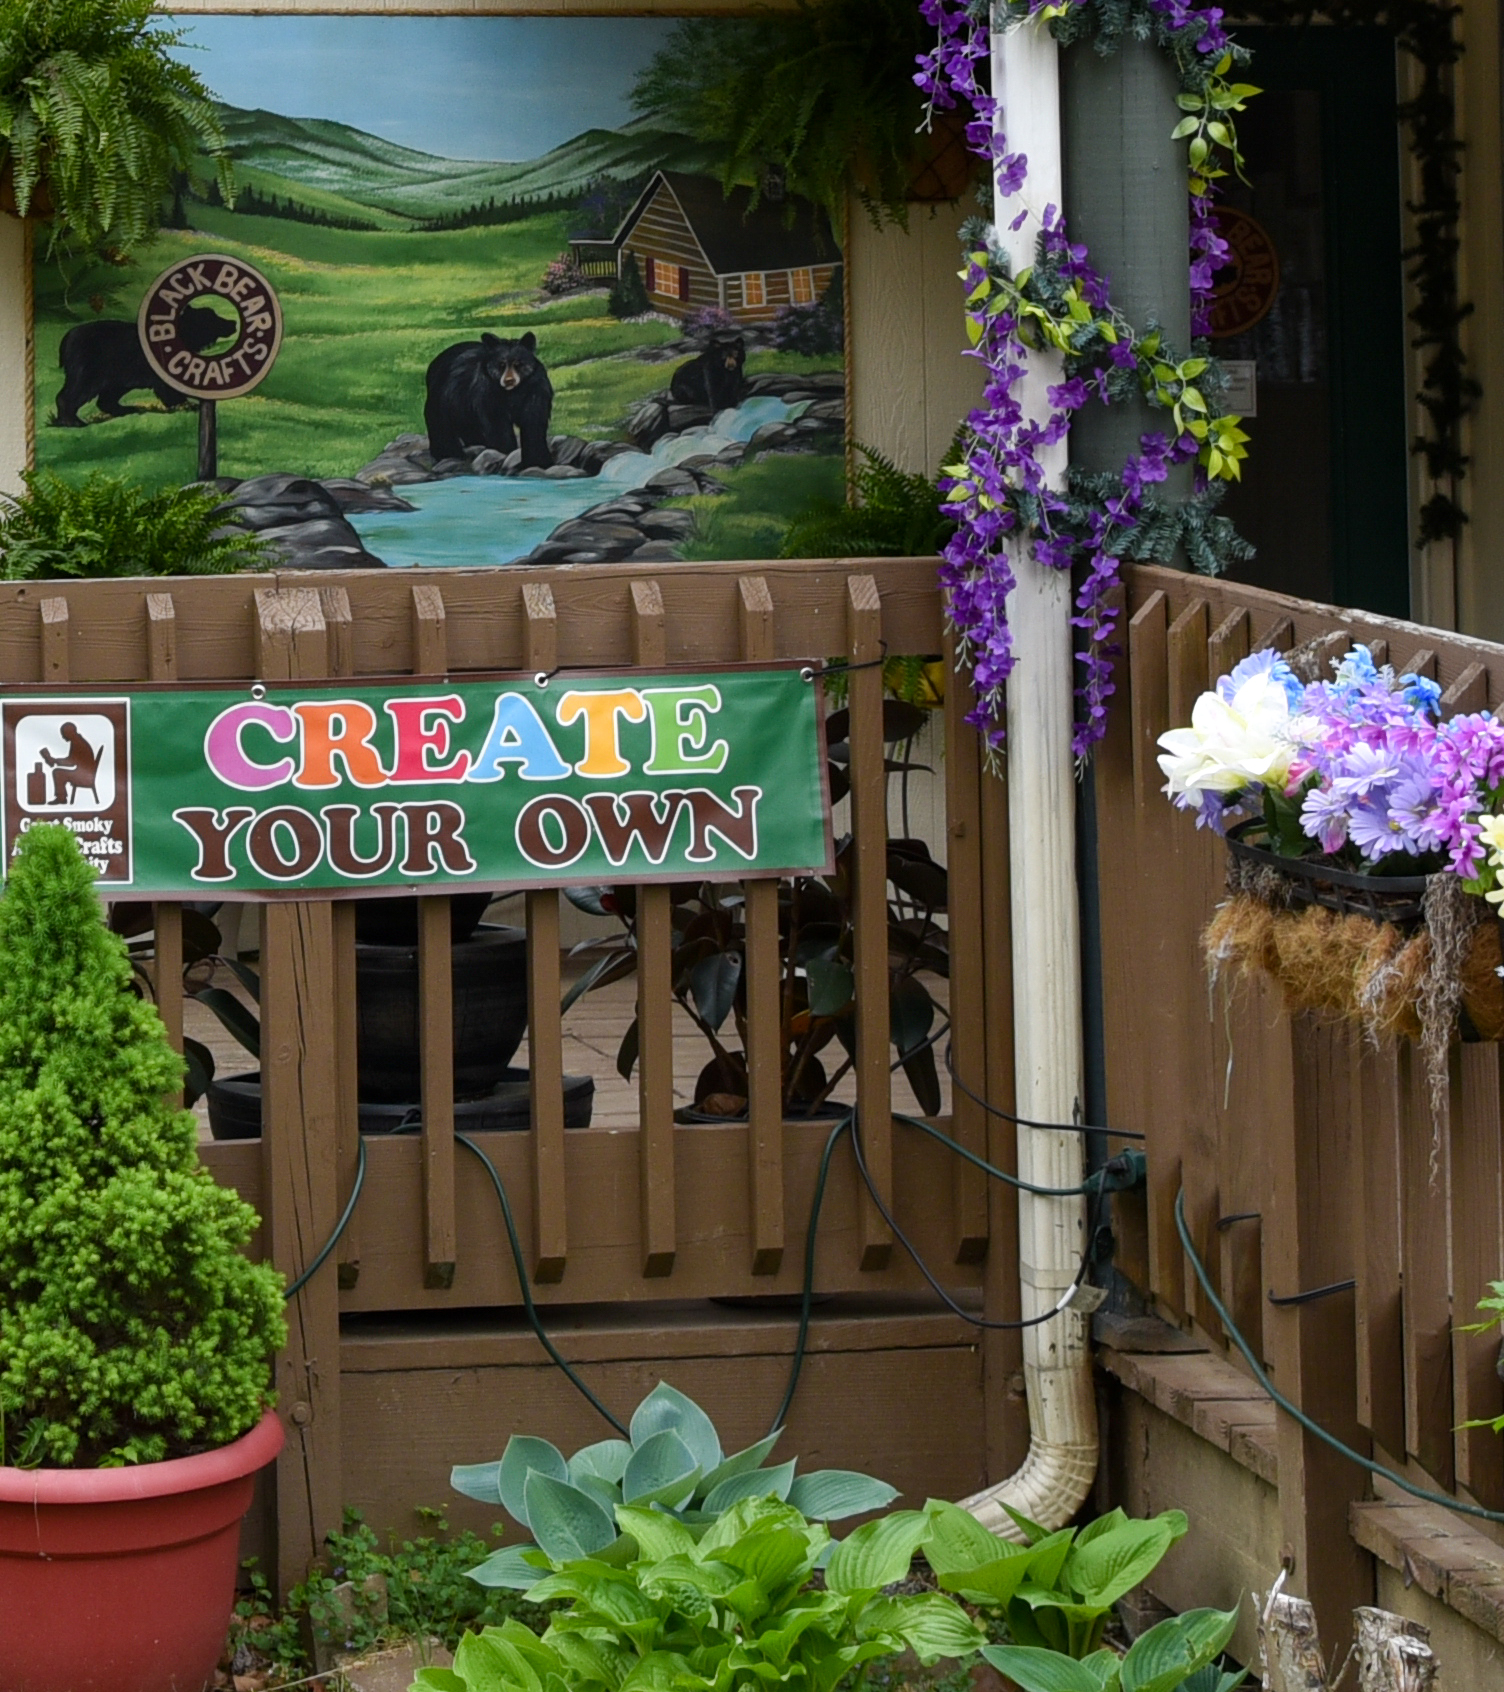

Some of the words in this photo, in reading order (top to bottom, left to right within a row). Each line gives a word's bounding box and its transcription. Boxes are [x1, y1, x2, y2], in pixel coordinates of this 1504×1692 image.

[149, 263, 214, 342] BLACK
[212, 263, 272, 334] BEAR
[168, 337, 268, 387] CRAFTS
[203, 683, 730, 792] CREATE
[63, 816, 114, 835] Smoky
[171, 799, 478, 883] YOUR
[514, 785, 764, 870] OWN
